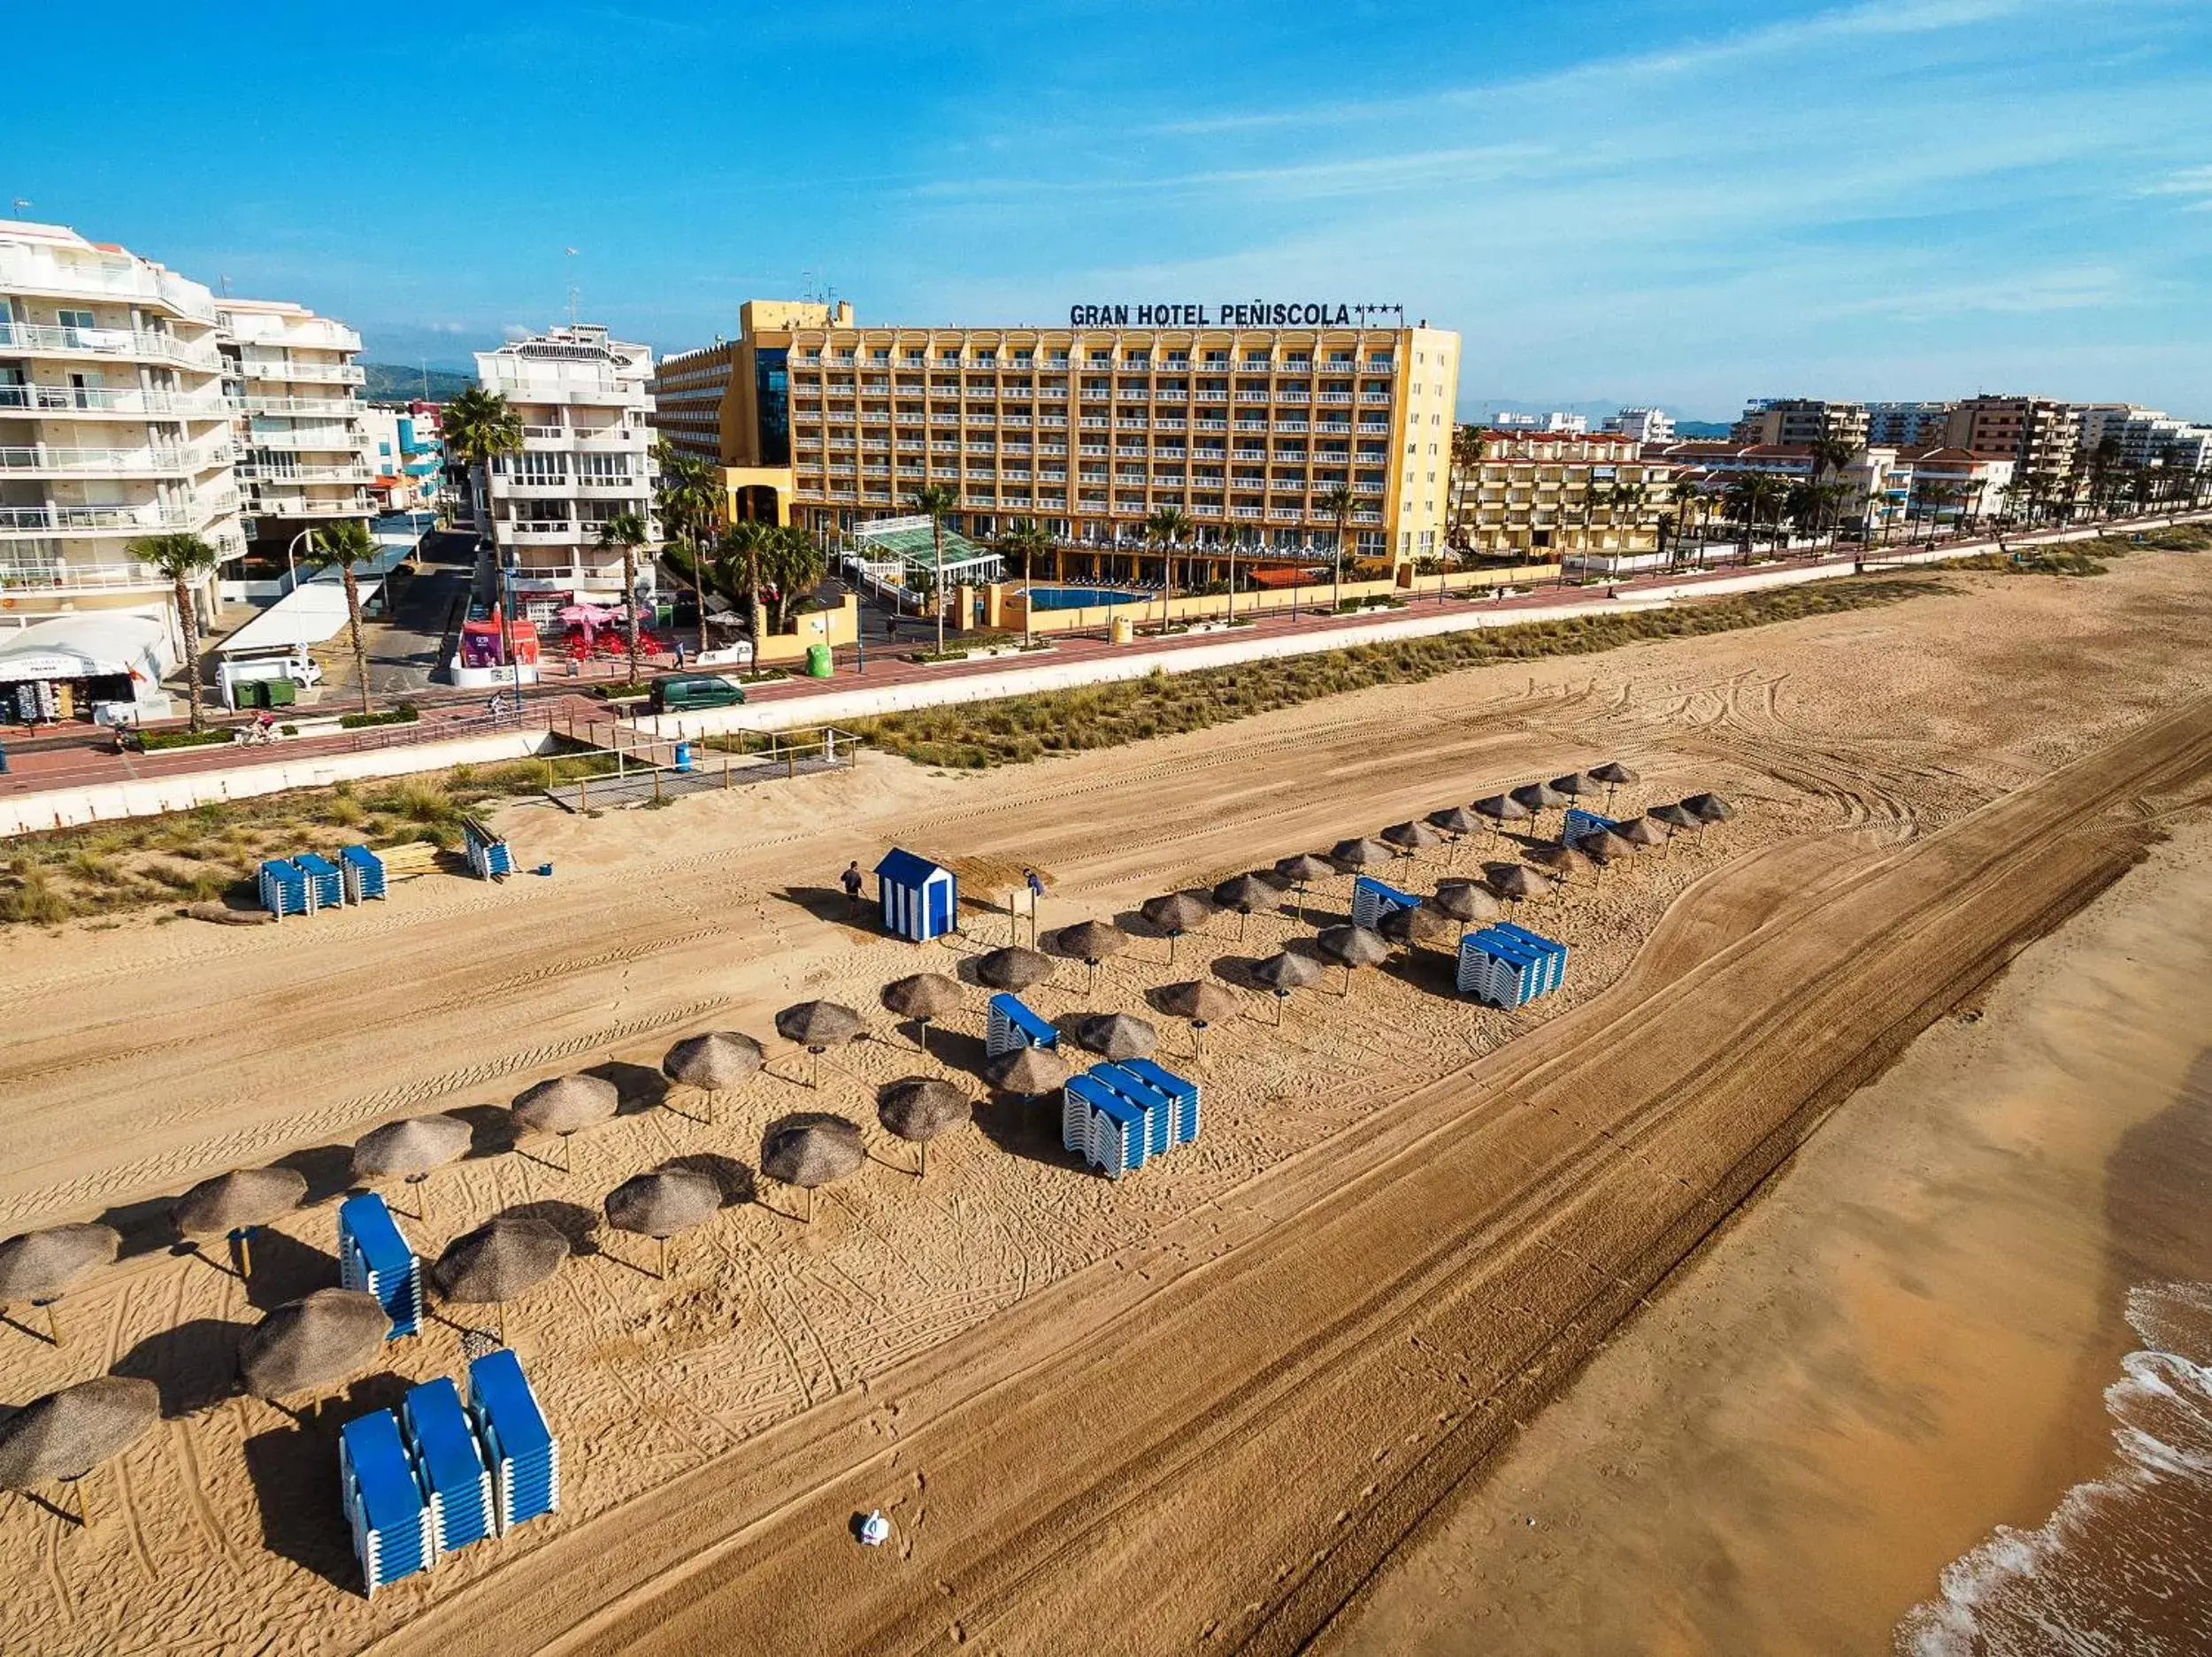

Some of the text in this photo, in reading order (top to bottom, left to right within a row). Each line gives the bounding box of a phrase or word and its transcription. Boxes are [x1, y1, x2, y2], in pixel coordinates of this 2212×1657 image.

[1071, 299, 1349, 326] GRAN HOTEL PEÑISCOLA
